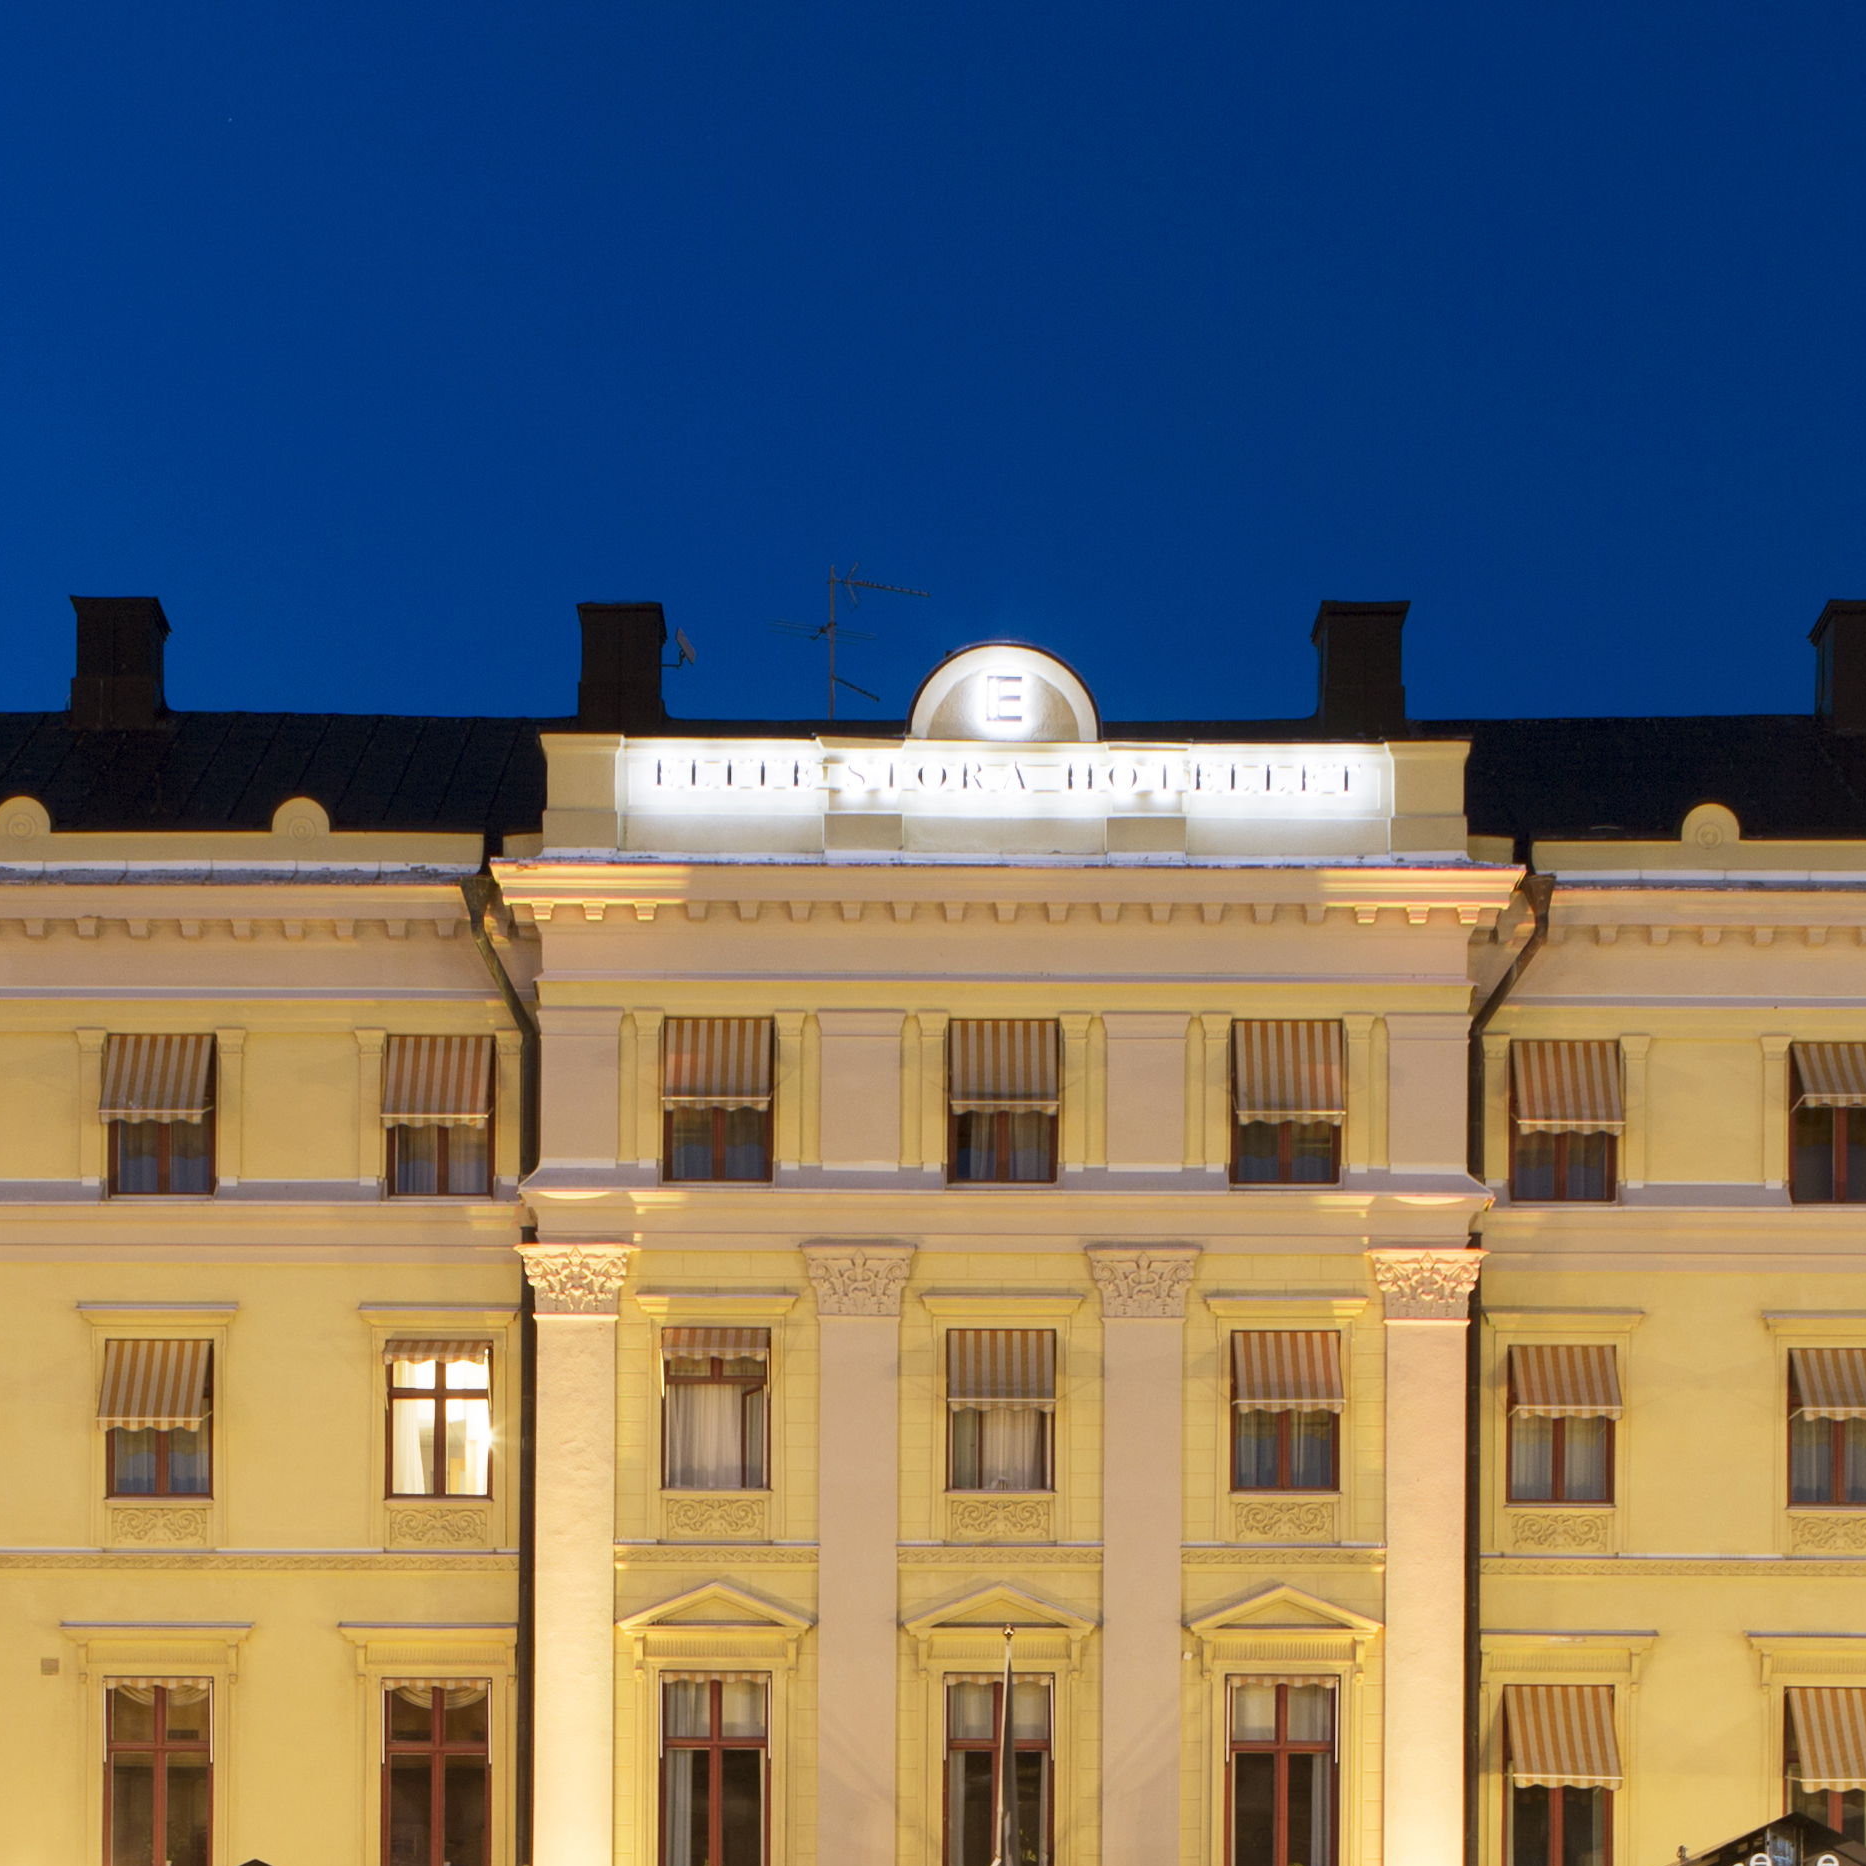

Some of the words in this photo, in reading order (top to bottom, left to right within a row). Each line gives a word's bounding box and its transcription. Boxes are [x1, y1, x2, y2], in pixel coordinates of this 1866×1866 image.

[986, 674, 1023, 723] E
[651, 758, 816, 791] ELITE
[845, 759, 1034, 793] STORA
[1064, 762, 1362, 796] HOTELLET
